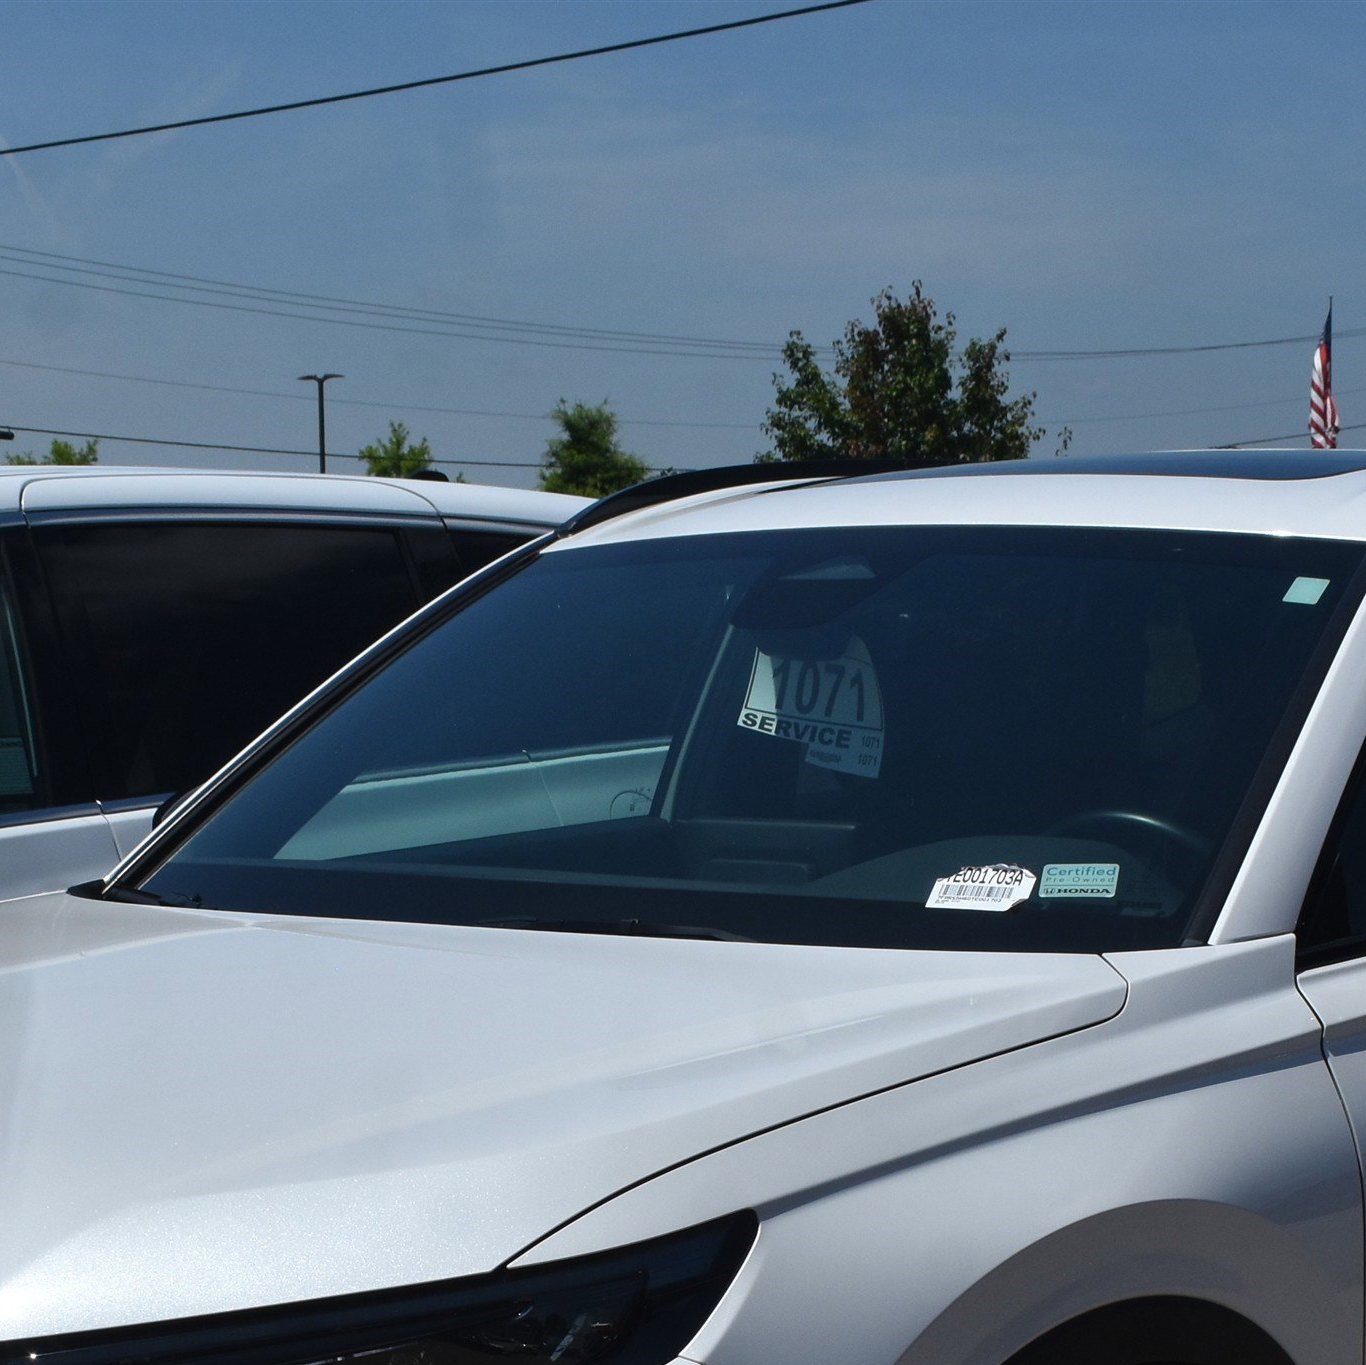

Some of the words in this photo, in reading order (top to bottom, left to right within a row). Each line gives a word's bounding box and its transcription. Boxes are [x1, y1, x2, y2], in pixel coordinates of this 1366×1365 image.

[772, 658, 865, 722] 1071
[741, 711, 852, 749] SERVICE
[860, 734, 880, 750] 1071
[857, 753, 877, 767] 1071
[1046, 866, 1116, 876] Certified
